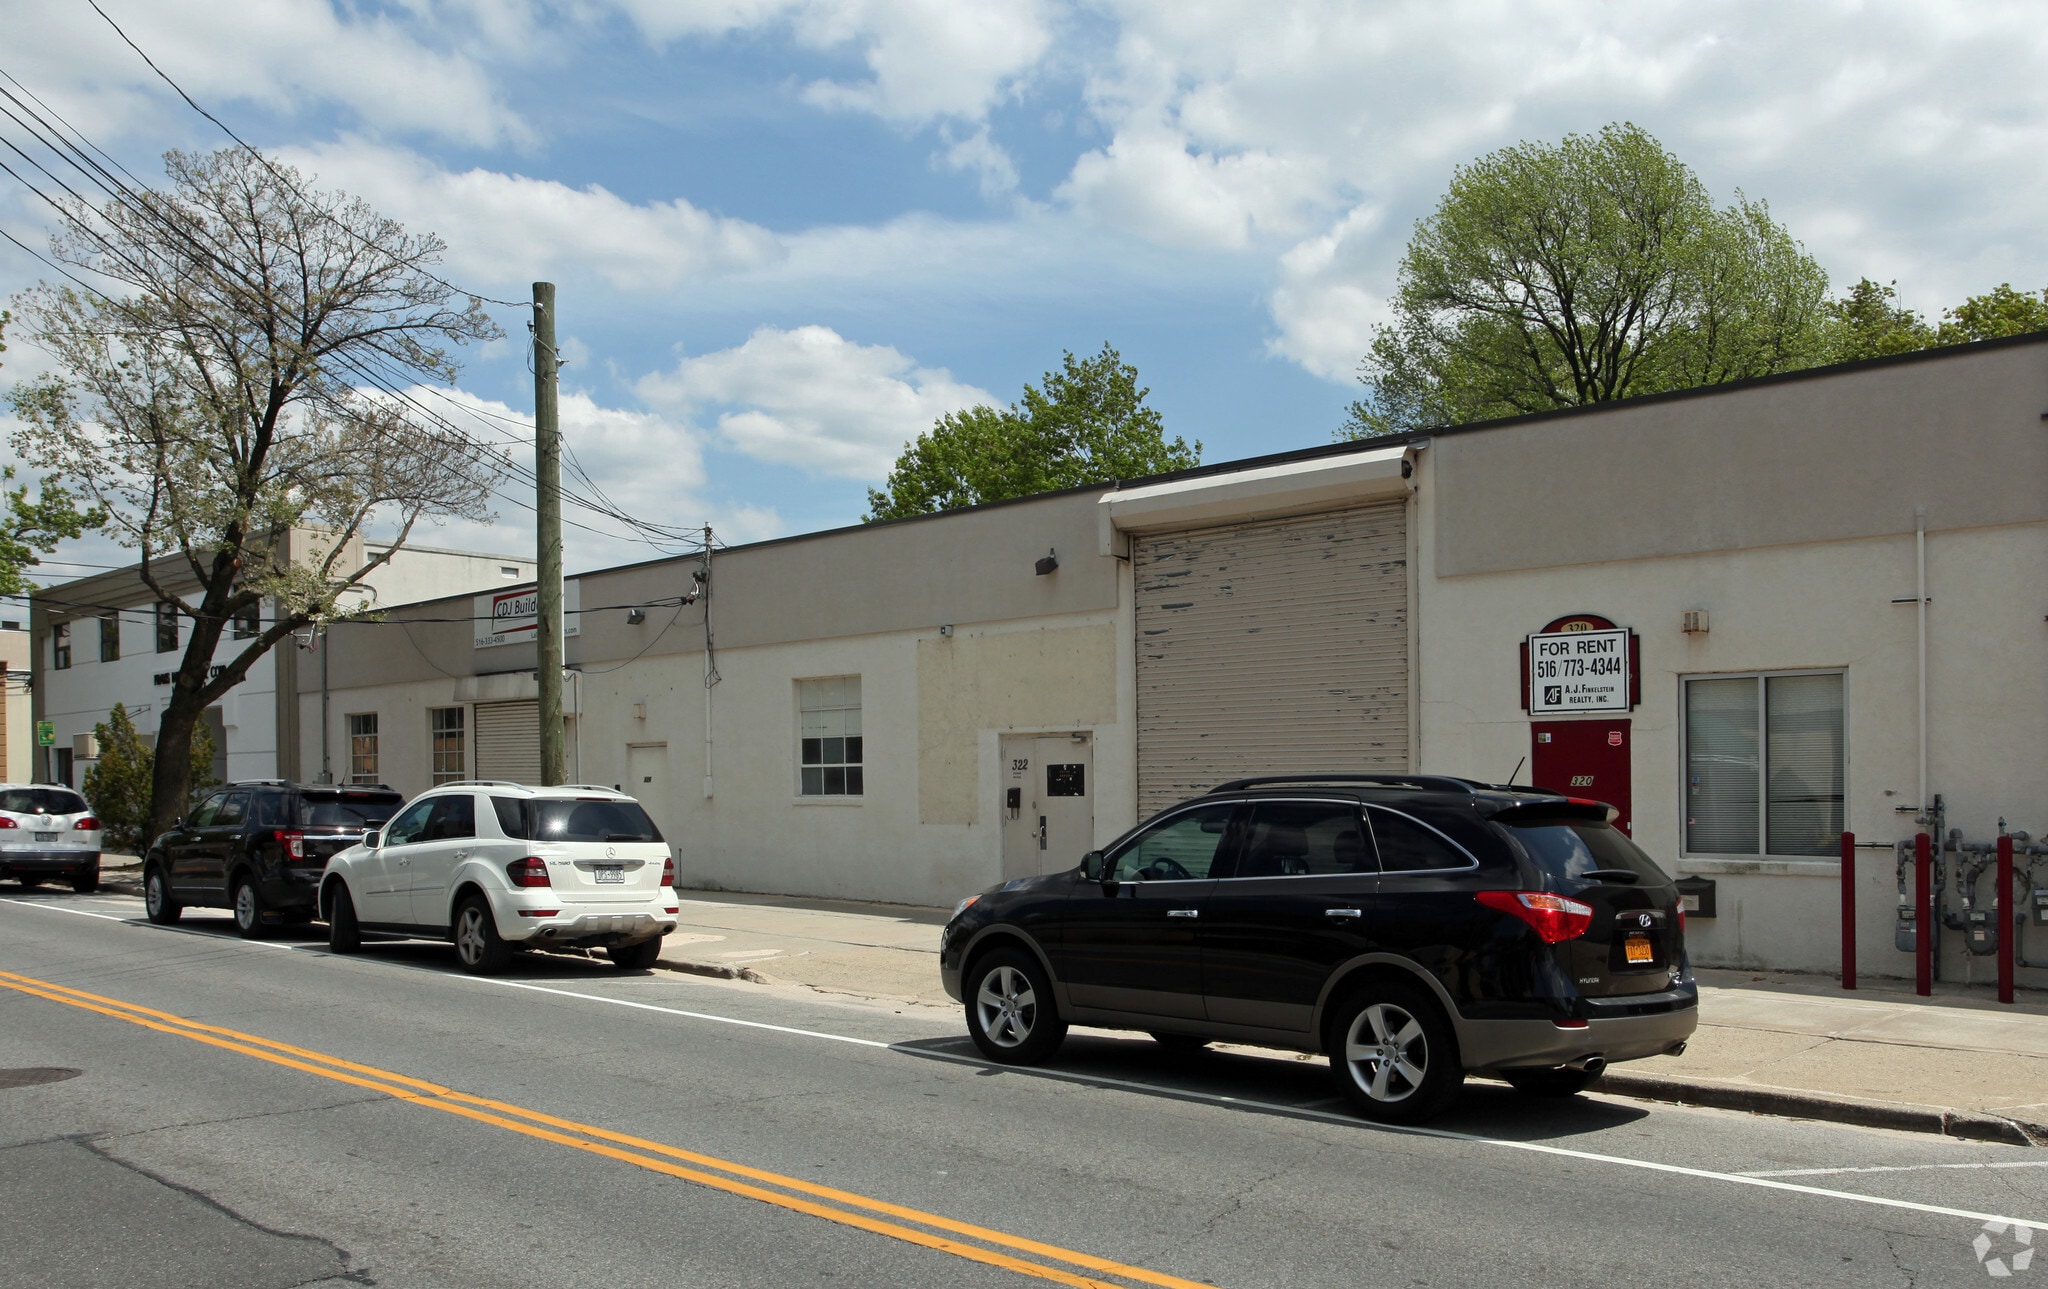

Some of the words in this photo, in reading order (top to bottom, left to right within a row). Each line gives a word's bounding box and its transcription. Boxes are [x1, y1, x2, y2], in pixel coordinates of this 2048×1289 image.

[496, 601, 512, 617] CDJ
[1540, 642, 1570, 656] FOR
[1577, 639, 1616, 654] RENT
[1538, 657, 1621, 678] 516/773-4344
[1569, 696, 1593, 704] REALTY,
[1596, 695, 1609, 703] INC.
[1012, 759, 1028, 771] 322
[1572, 776, 1592, 786] 320
